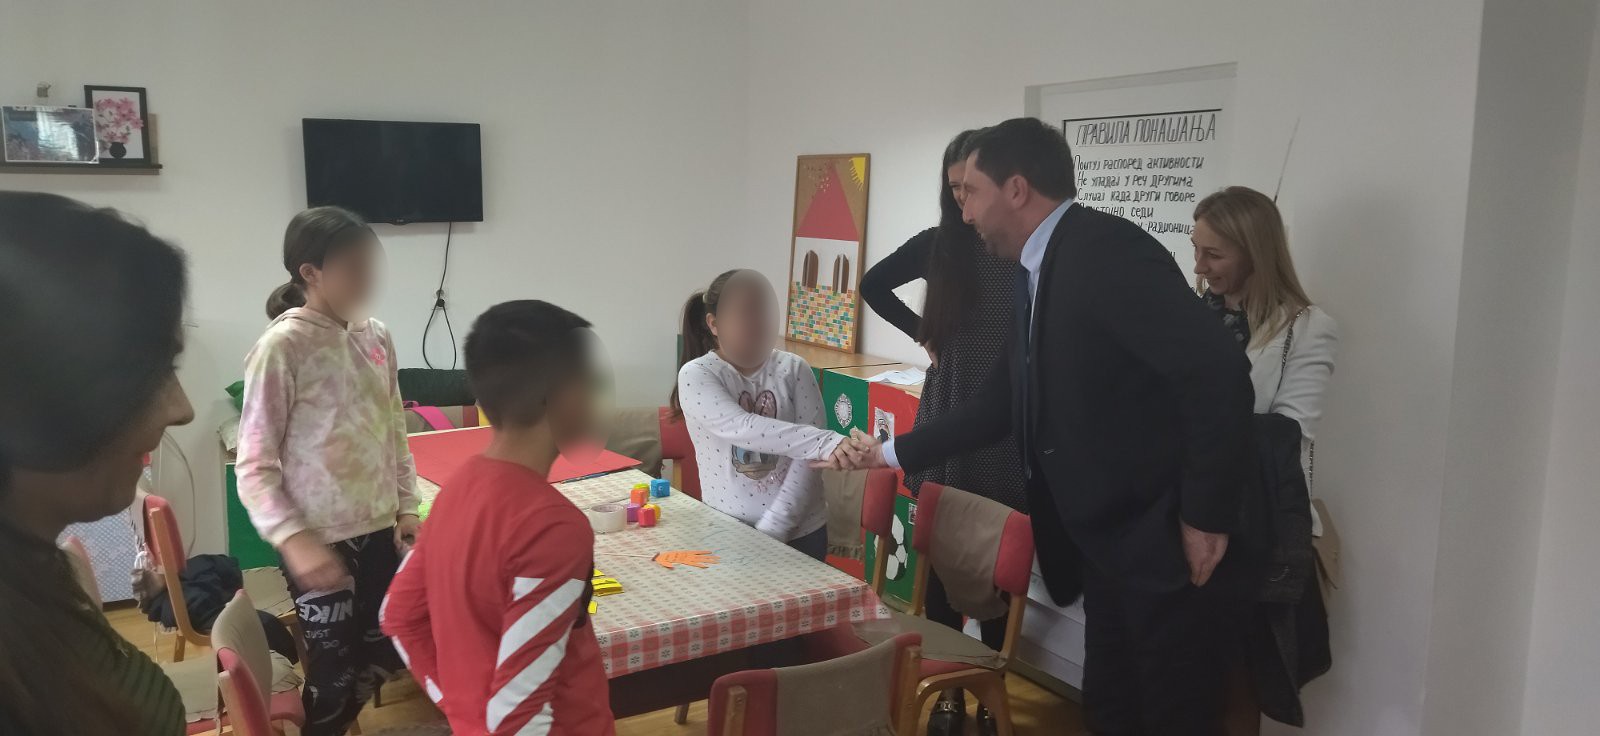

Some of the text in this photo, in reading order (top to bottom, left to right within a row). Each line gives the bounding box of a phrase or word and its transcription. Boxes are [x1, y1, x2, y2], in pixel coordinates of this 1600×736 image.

[1076, 113, 1216, 145] ПРАВИЛА ПОНАШАЊА
[1077, 171, 1088, 186] Не
[1080, 202, 1154, 220] тојно седи
[298, 599, 353, 624] NIKE
[304, 628, 331, 639] JUST
